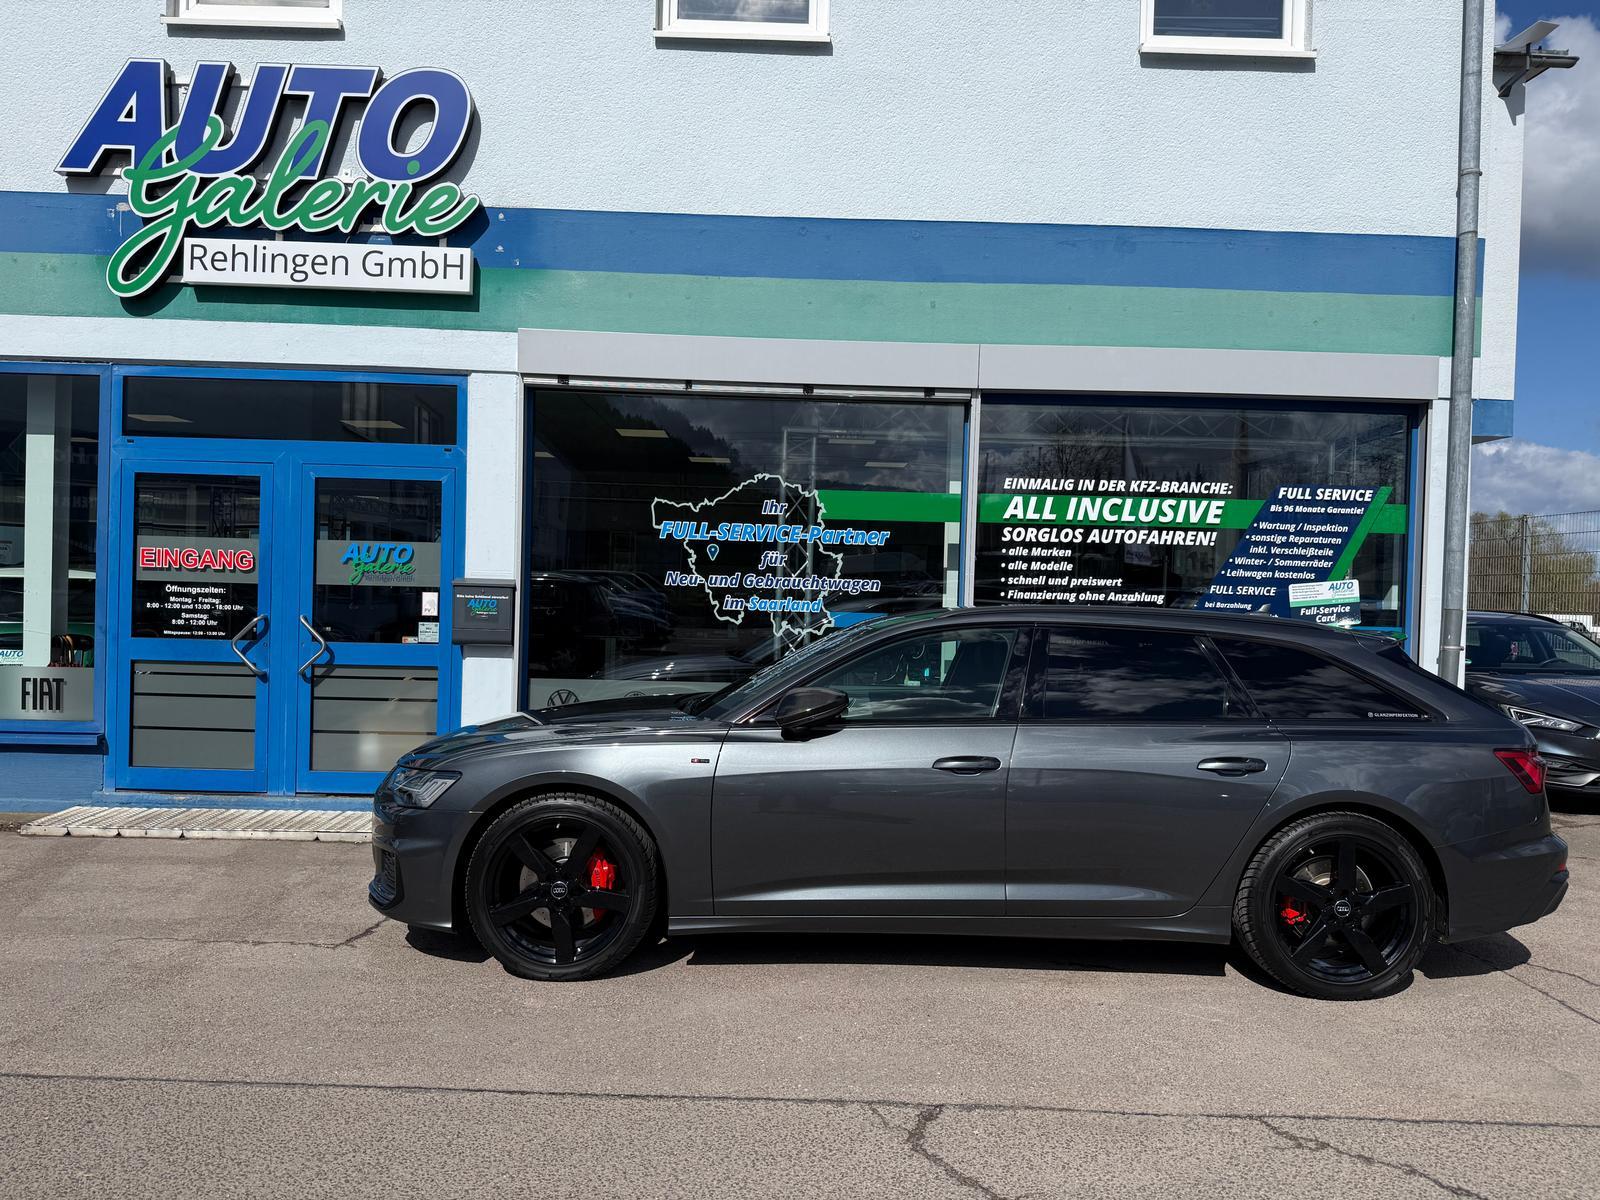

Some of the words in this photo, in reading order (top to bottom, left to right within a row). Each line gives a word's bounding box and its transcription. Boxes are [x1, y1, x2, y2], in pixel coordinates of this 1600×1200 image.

[54, 57, 475, 183] AUTO
[106, 114, 480, 297] Galerie
[190, 243, 349, 282] Rehlingen
[361, 250, 465, 280] GmbH
[1003, 478, 1074, 491] EINMALIG
[1077, 479, 1095, 491] IN
[1098, 480, 1127, 492] DER
[1130, 481, 1234, 495] KFZ-BRANCHE:
[1278, 487, 1312, 500] FULL
[1315, 488, 1374, 502] SERVICE
[762, 500, 788, 515] Ihr
[1003, 496, 1057, 520] ALL
[1065, 497, 1226, 524] INCLUSIVE
[1270, 504, 1283, 513] Bis
[1284, 505, 1294, 513] 96
[1295, 505, 1326, 514] Monate
[1327, 506, 1364, 515] Garantie!
[659, 521, 891, 545] FULL-SERVICE-Partner
[1259, 521, 1296, 532] Wartung
[1303, 523, 1349, 534] Inspektion
[1001, 527, 1084, 543] SORGLOS
[1087, 529, 1218, 546] AUTOFAHREN!
[1250, 533, 1287, 544] sonstige
[1288, 534, 1342, 546] Reparaturen
[342, 543, 414, 565] AUTO
[1008, 547, 1028, 556] alle
[1030, 548, 1072, 557] Marken
[1249, 545, 1268, 554] inkl.
[1270, 546, 1334, 557] Verschleißteile
[140, 547, 254, 570] EINGANG
[758, 551, 788, 569] für
[1234, 557, 1267, 566] Winter-
[1274, 558, 1333, 568] Sommerräder
[1008, 561, 1028, 571] alle
[1030, 562, 1074, 571] Modelle
[1007, 575, 1046, 585] schnell
[1047, 577, 1068, 586] und
[1070, 578, 1123, 588] preiswert
[1226, 569, 1273, 580] Leihwagen
[1274, 570, 1316, 580] kostenlos
[166, 584, 227, 595] Öffnungszeiten:
[664, 571, 704, 587] Neu-
[708, 573, 741, 588] und
[743, 574, 881, 595] Gebrauchtwagen
[1328, 581, 1354, 591] AUTO
[1007, 590, 1077, 602] Finanzierung
[1078, 591, 1105, 601] ohne
[1106, 592, 1165, 605] Anzahlung
[1209, 585, 1234, 595] FULL
[1236, 585, 1277, 596] SERVICE
[723, 595, 745, 611] im
[748, 596, 823, 612] Saarland
[1205, 601, 1215, 609] bei
[1216, 601, 1252, 611] Barzahlung
[1300, 605, 1351, 616] Full-Service
[181, 612, 210, 620] Samstag:
[1315, 614, 1337, 623] Card
[21, 678, 65, 711] FIAT
